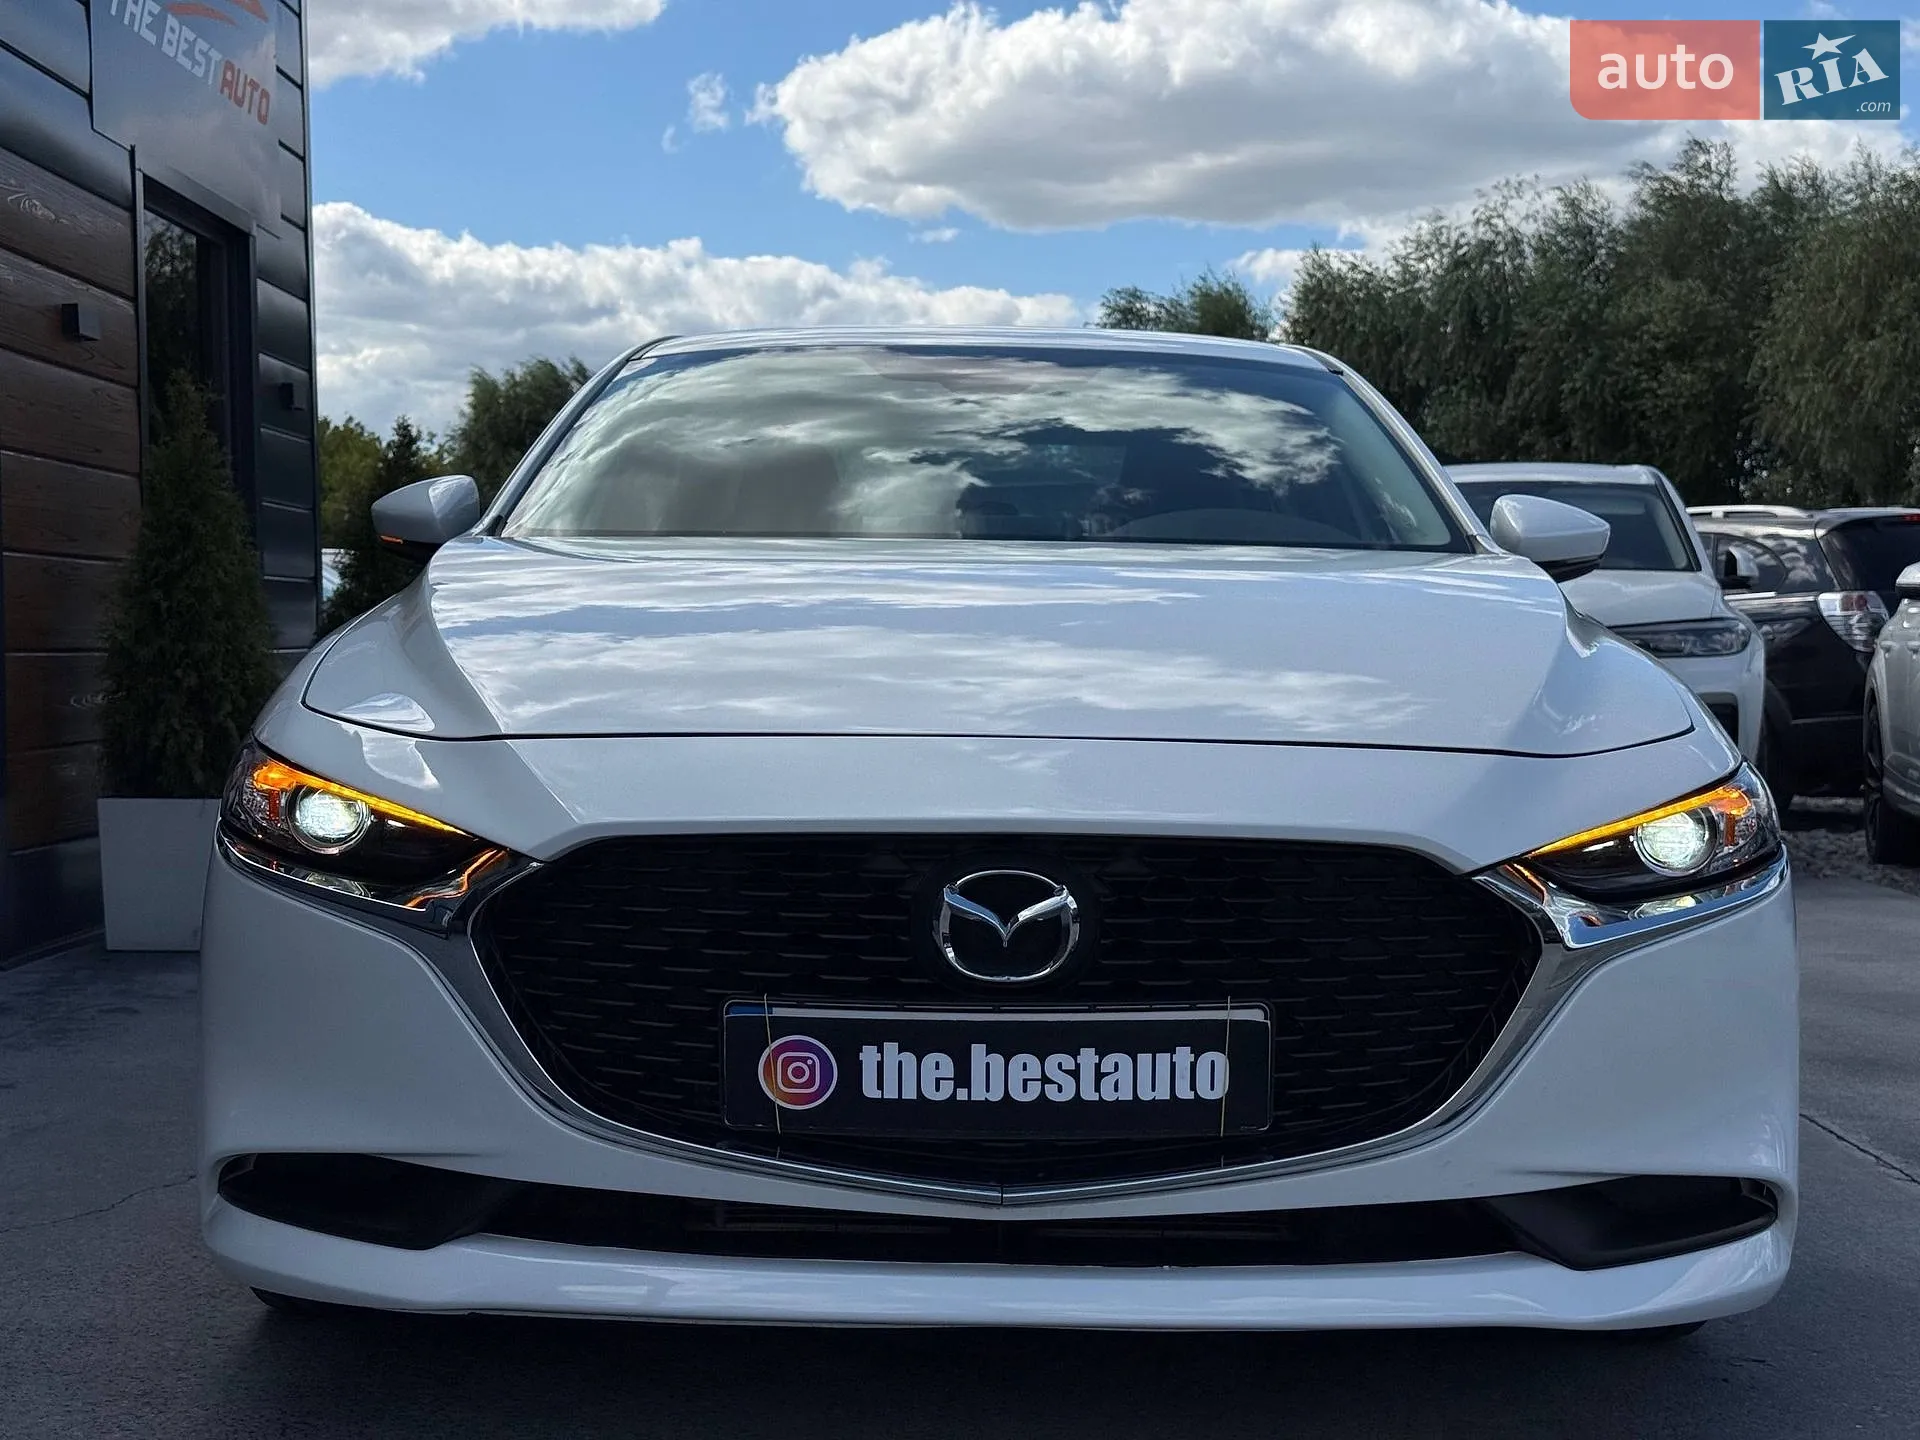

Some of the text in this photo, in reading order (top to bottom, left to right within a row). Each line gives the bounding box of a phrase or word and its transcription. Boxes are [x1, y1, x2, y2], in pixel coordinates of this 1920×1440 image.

[161, 14, 222, 85] BEST
[220, 60, 270, 125] AUTO
[859, 1042, 1229, 1101] the.bestauto
